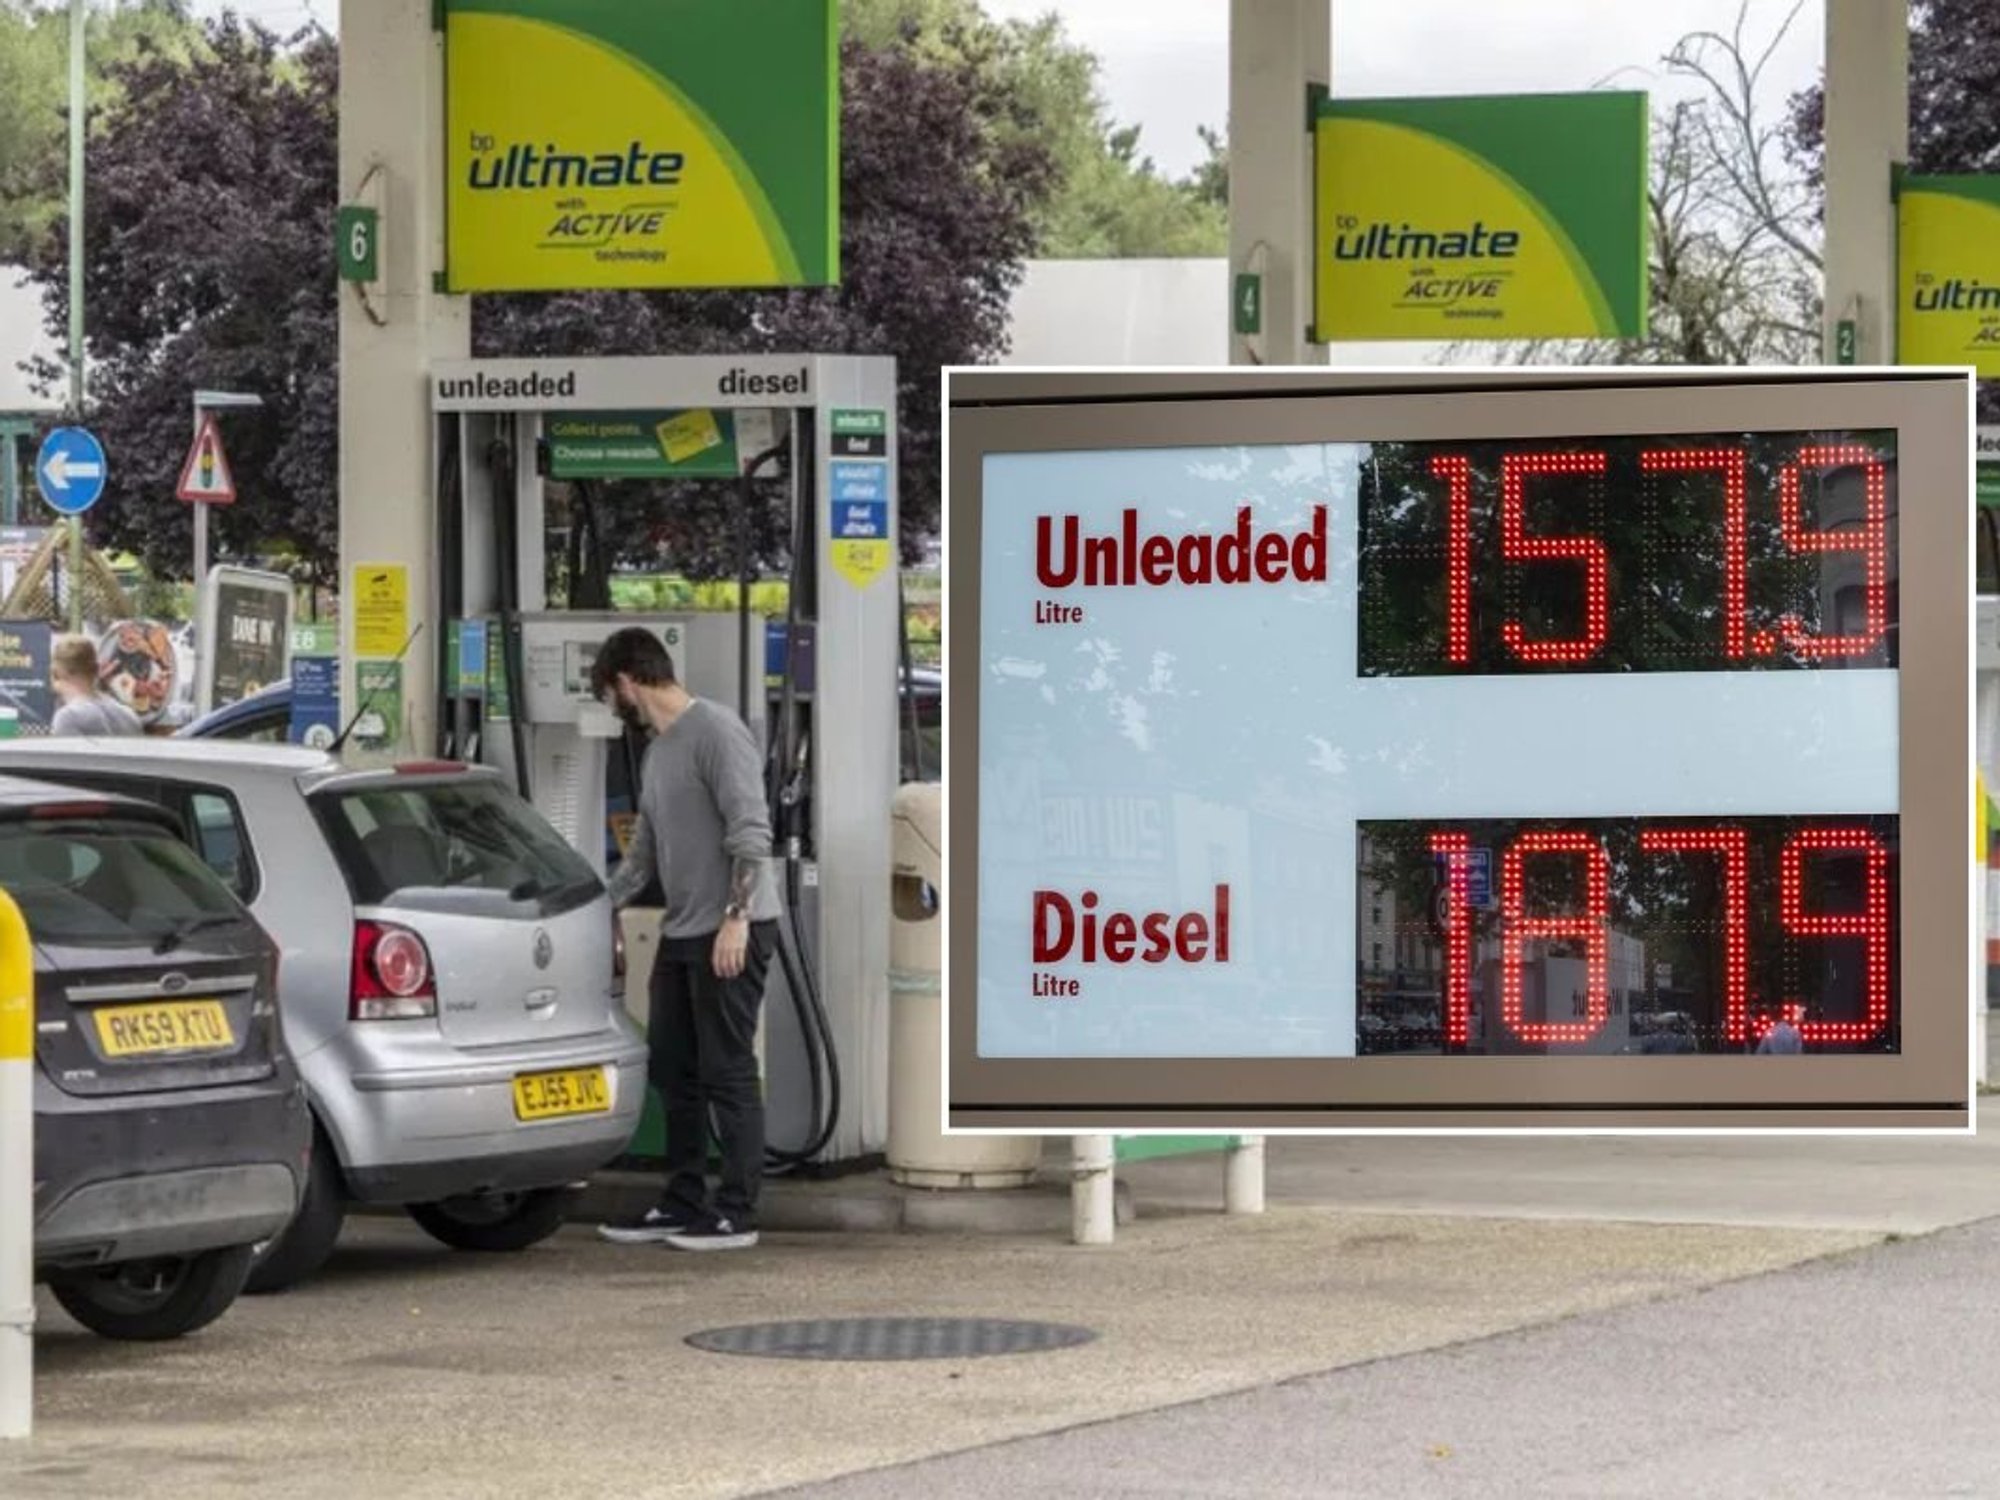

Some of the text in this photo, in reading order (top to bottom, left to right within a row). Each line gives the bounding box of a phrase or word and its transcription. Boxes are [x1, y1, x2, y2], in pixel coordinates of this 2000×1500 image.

[470, 131, 494, 154] bp
[469, 142, 684, 189] ultimate
[555, 196, 586, 210] with
[548, 213, 664, 236] ACTIVE
[350, 221, 367, 261] 6
[1335, 222, 1519, 260] ultimate
[594, 249, 667, 262] technology
[1403, 279, 1504, 297] ACTIVE
[1242, 287, 1255, 318] 4
[1840, 330, 1852, 356] 2
[438, 367, 808, 398] unleaded diesel
[1036, 445, 1886, 663] Unleaded 157.9
[1036, 600, 1083, 624] Litre
[664, 627, 679, 645] 6
[1032, 828, 1887, 1045] Diesel 187.9
[1032, 973, 1080, 996] Litre
[109, 1011, 177, 1049] RK59
[178, 1007, 223, 1042] XTU
[520, 1076, 570, 1111] EJ55
